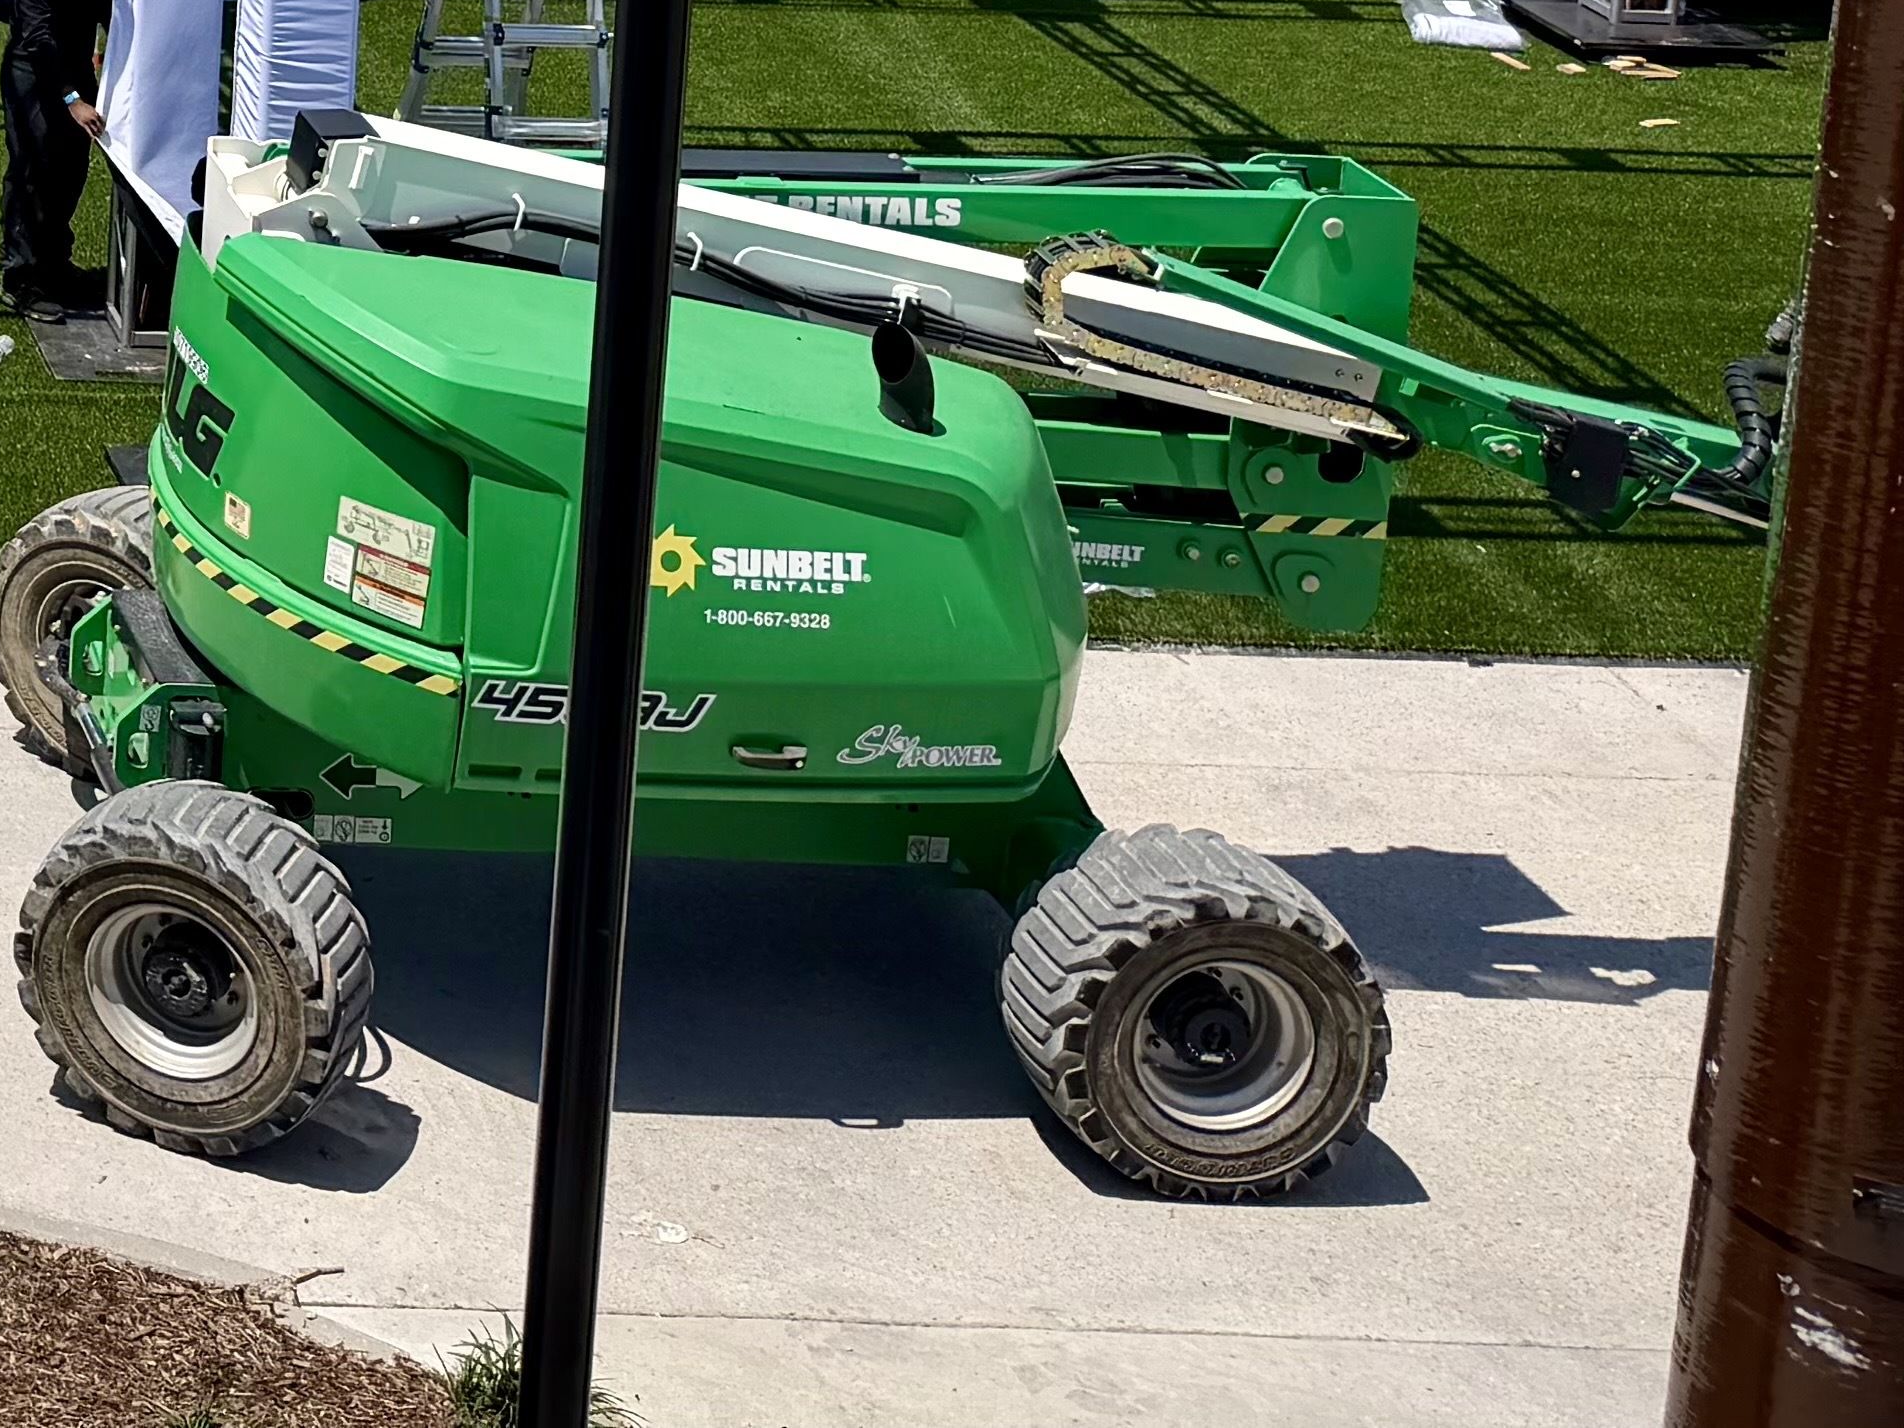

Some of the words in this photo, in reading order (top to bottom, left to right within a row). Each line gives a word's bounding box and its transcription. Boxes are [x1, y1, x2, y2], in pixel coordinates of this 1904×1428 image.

[733, 578, 845, 595] RENTALS
[703, 608, 831, 630] 1-800-667-9328
[471, 678, 717, 733] 45AJ
